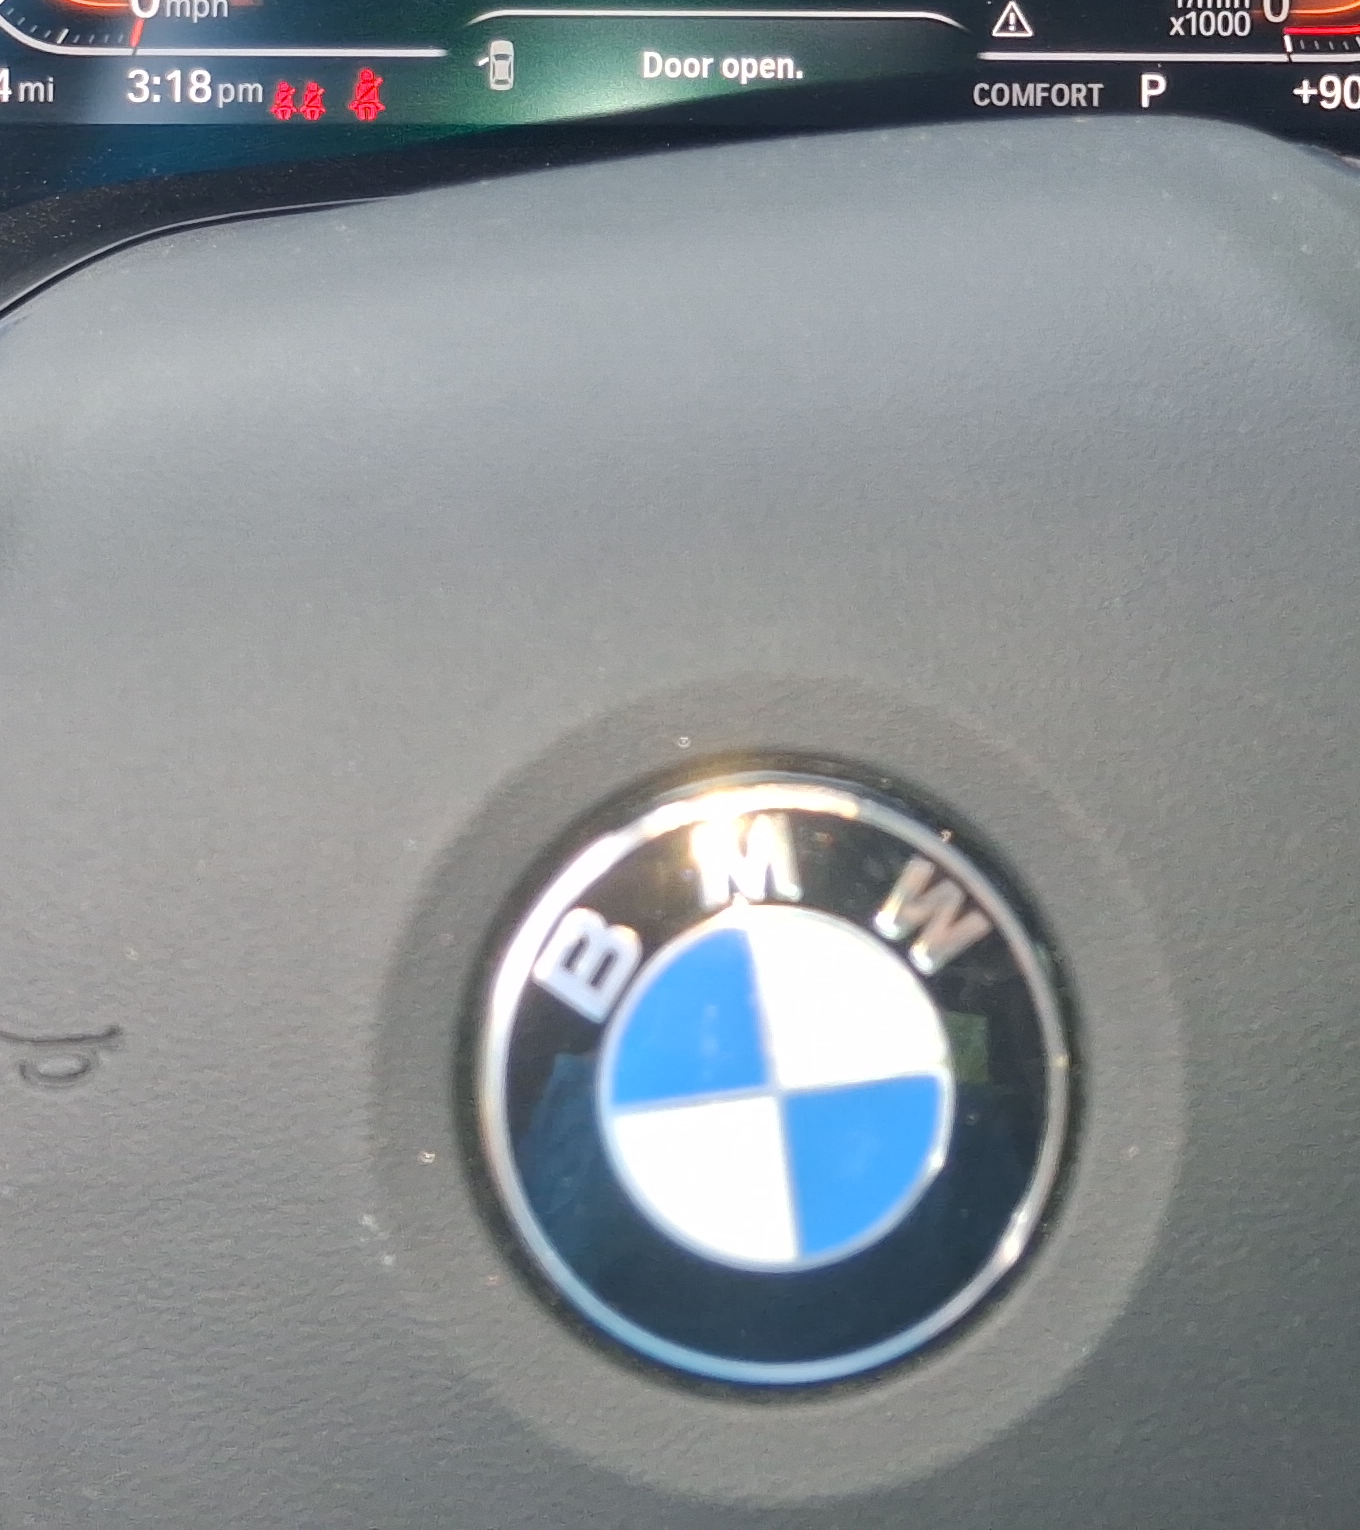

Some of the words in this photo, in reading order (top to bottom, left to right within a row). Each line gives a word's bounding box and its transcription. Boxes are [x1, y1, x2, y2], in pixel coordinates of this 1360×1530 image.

[1169, 11, 1252, 38] x1000
[642, 52, 714, 80] Door
[722, 53, 804, 85] open.
[18, 77, 55, 103] mi
[127, 72, 212, 103] 3:18
[218, 79, 264, 109] pm
[973, 82, 1104, 108] COMFORT
[1140, 75, 1167, 108] P
[533, 812, 995, 1023] BMW
